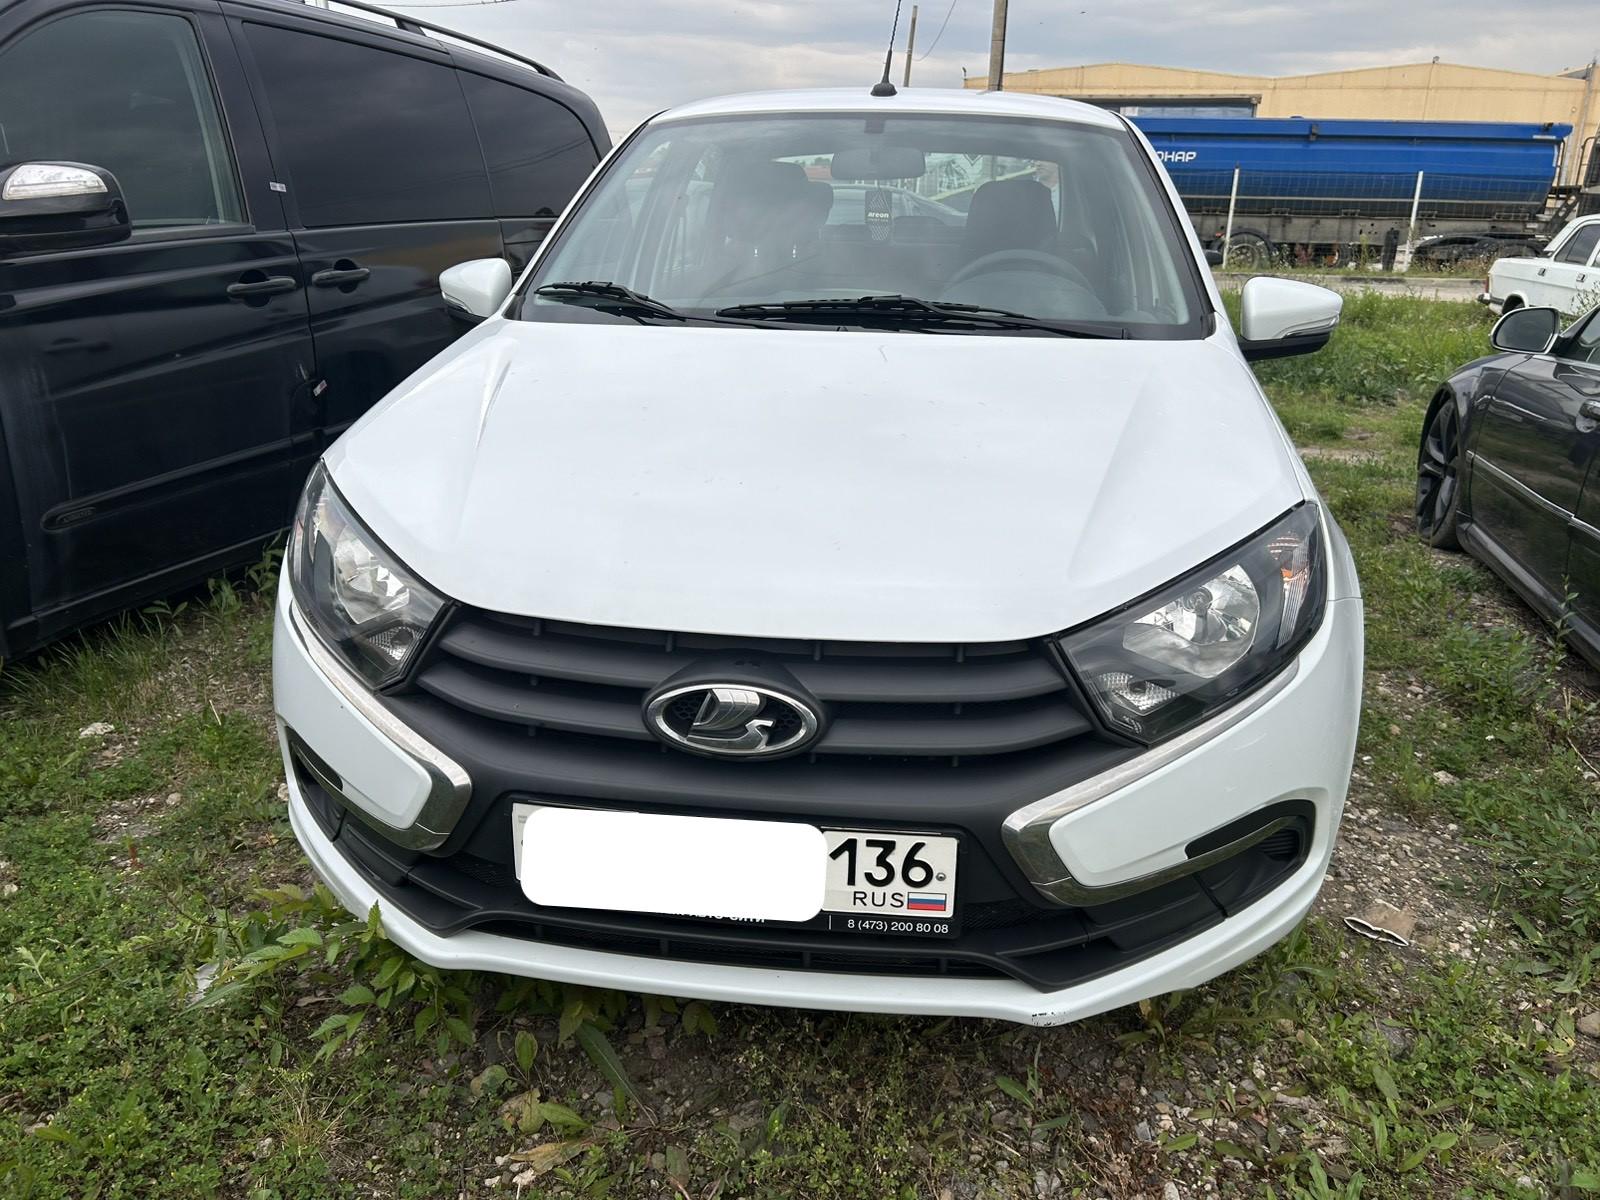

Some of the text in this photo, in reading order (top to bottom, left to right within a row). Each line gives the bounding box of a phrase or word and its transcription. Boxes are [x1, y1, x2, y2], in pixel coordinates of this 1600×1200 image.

[1156, 151, 1197, 162] ОНАР
[829, 838, 933, 888] 136
[853, 891, 904, 908] RUS
[847, 919, 949, 934] 8 (473) 200 80 08
